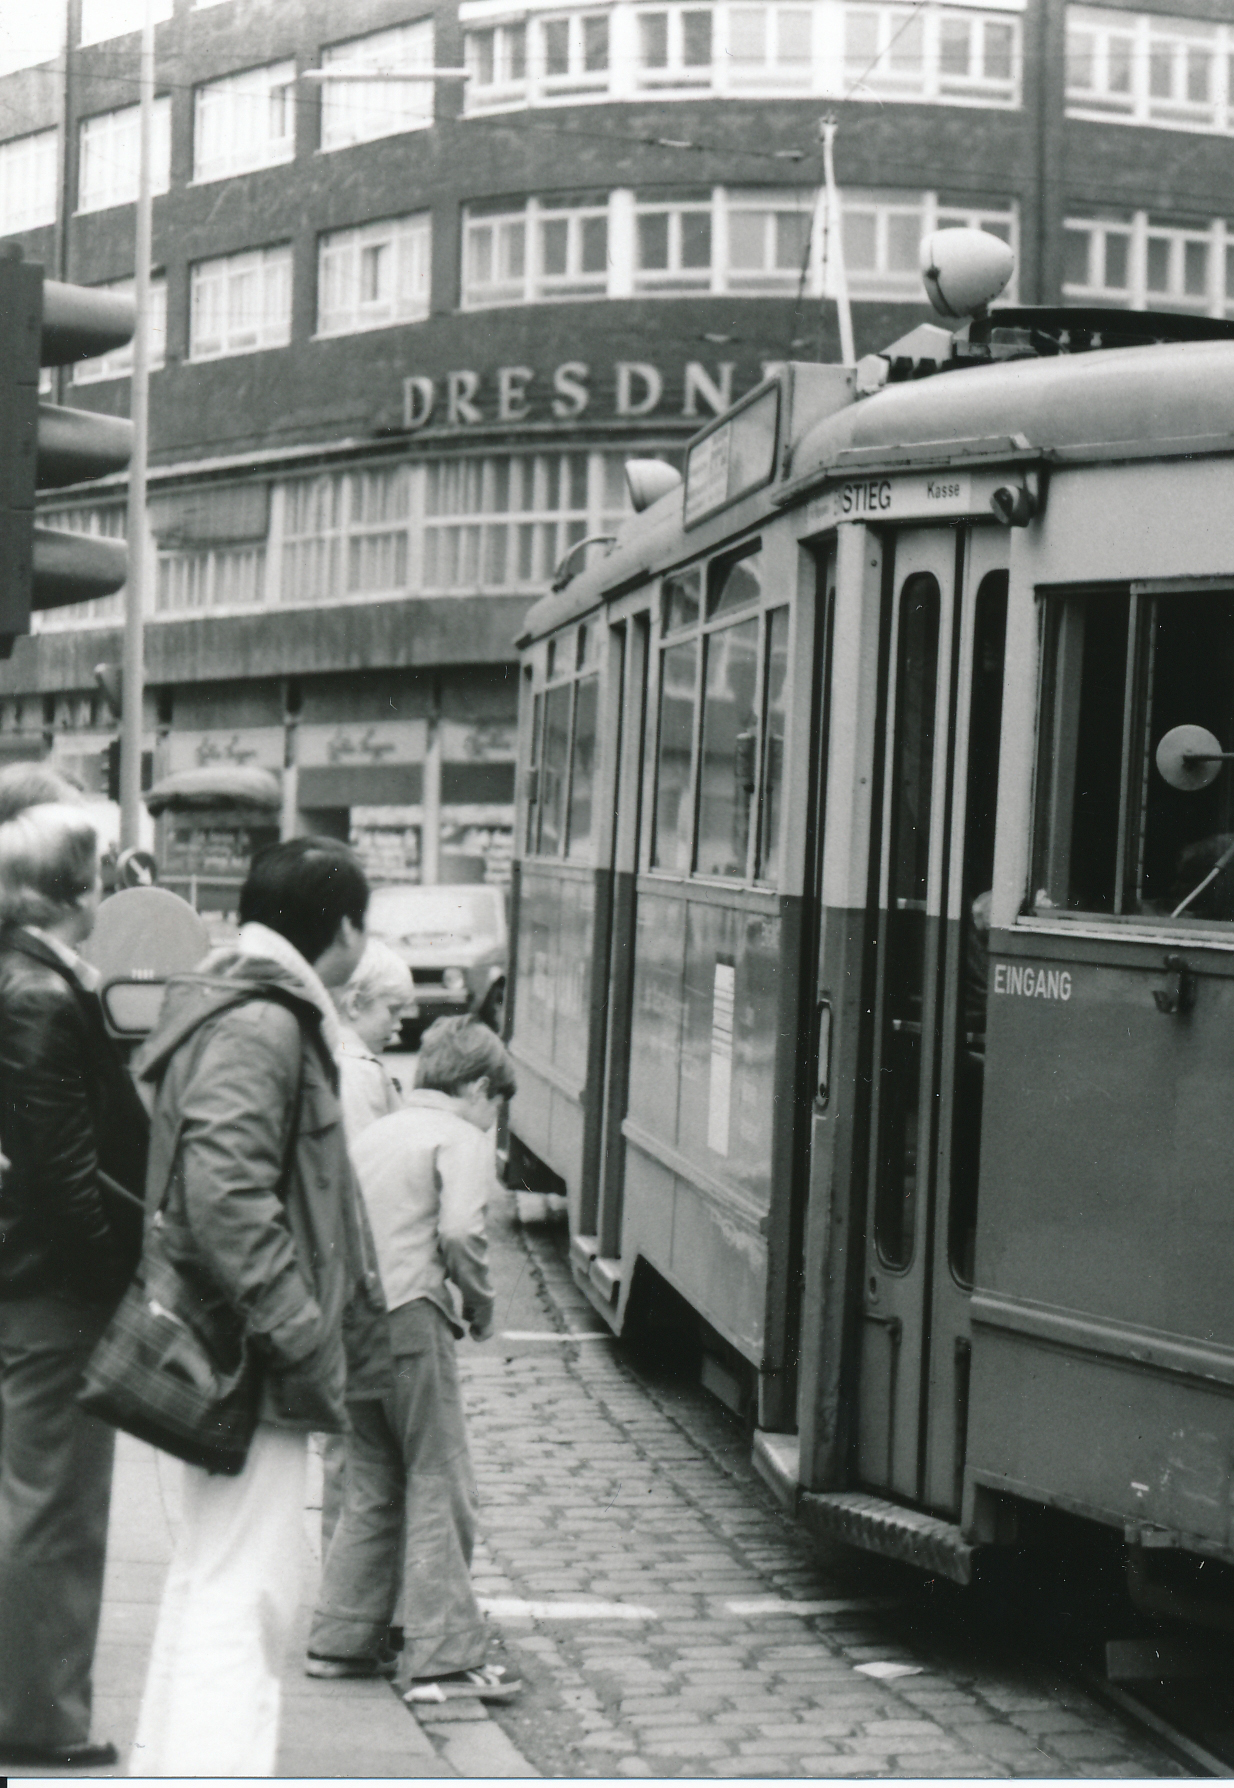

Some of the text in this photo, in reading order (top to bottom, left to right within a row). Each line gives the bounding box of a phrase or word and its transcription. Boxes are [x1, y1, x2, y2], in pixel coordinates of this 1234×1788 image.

[835, 480, 892, 514] STIEG
[926, 481, 961, 499] Kasse
[994, 963, 1072, 1001] EINGANG
